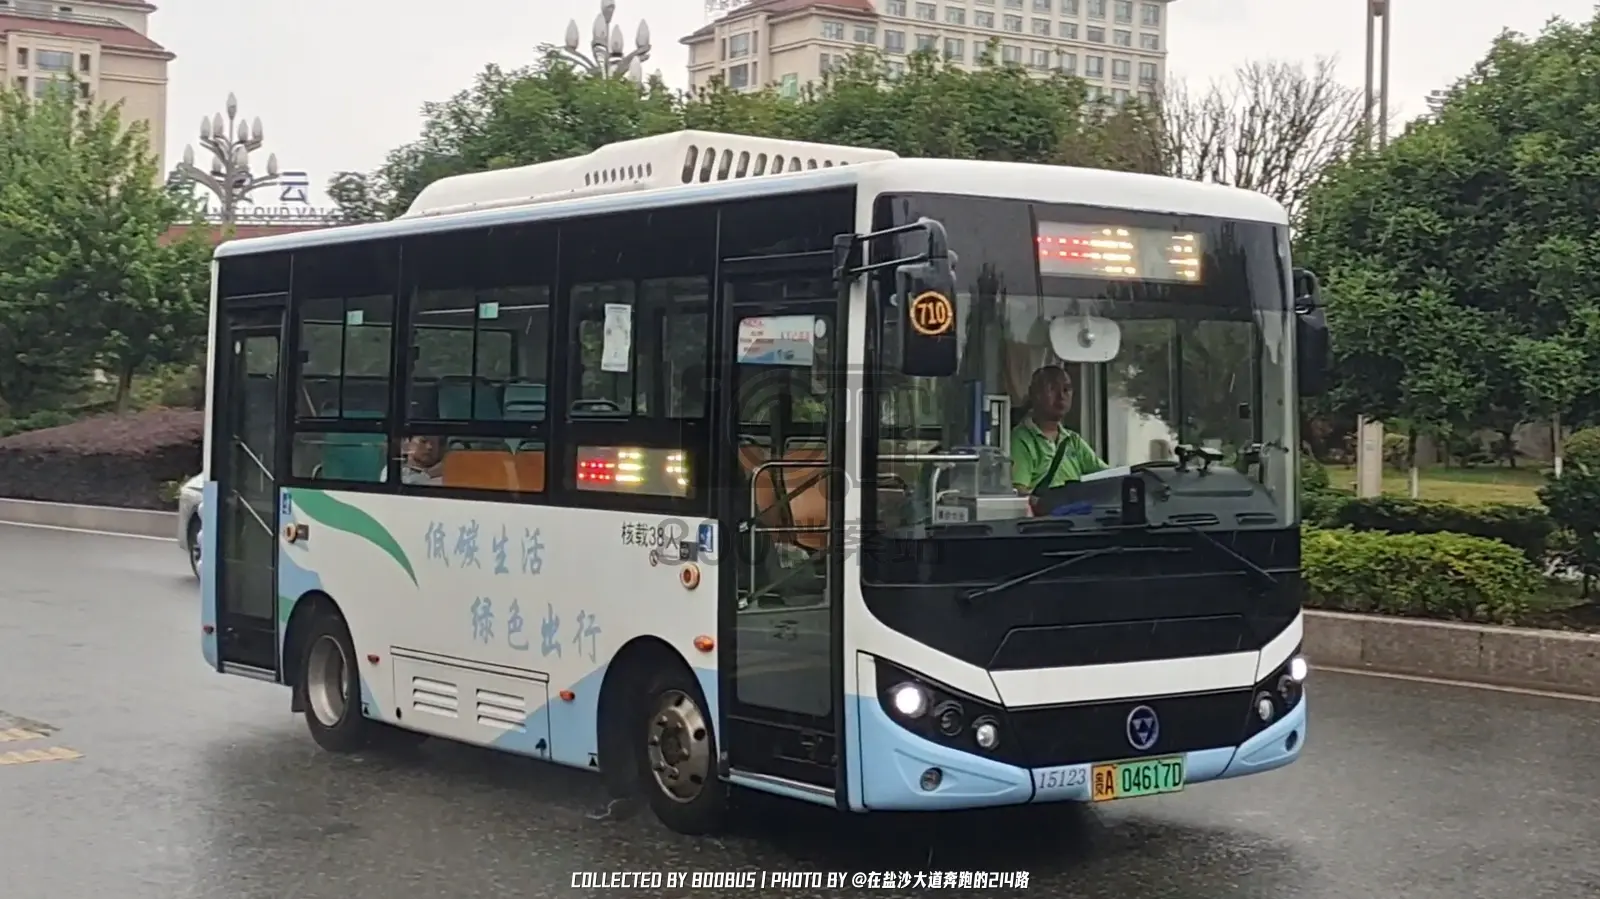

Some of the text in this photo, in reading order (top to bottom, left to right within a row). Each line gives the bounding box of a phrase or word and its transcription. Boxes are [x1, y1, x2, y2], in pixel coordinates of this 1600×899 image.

[917, 301, 946, 325] 710
[424, 519, 546, 576] 低碳生活
[620, 520, 679, 550] 核载38人
[470, 596, 602, 663] 绿色出行
[1038, 768, 1087, 789] 15123
